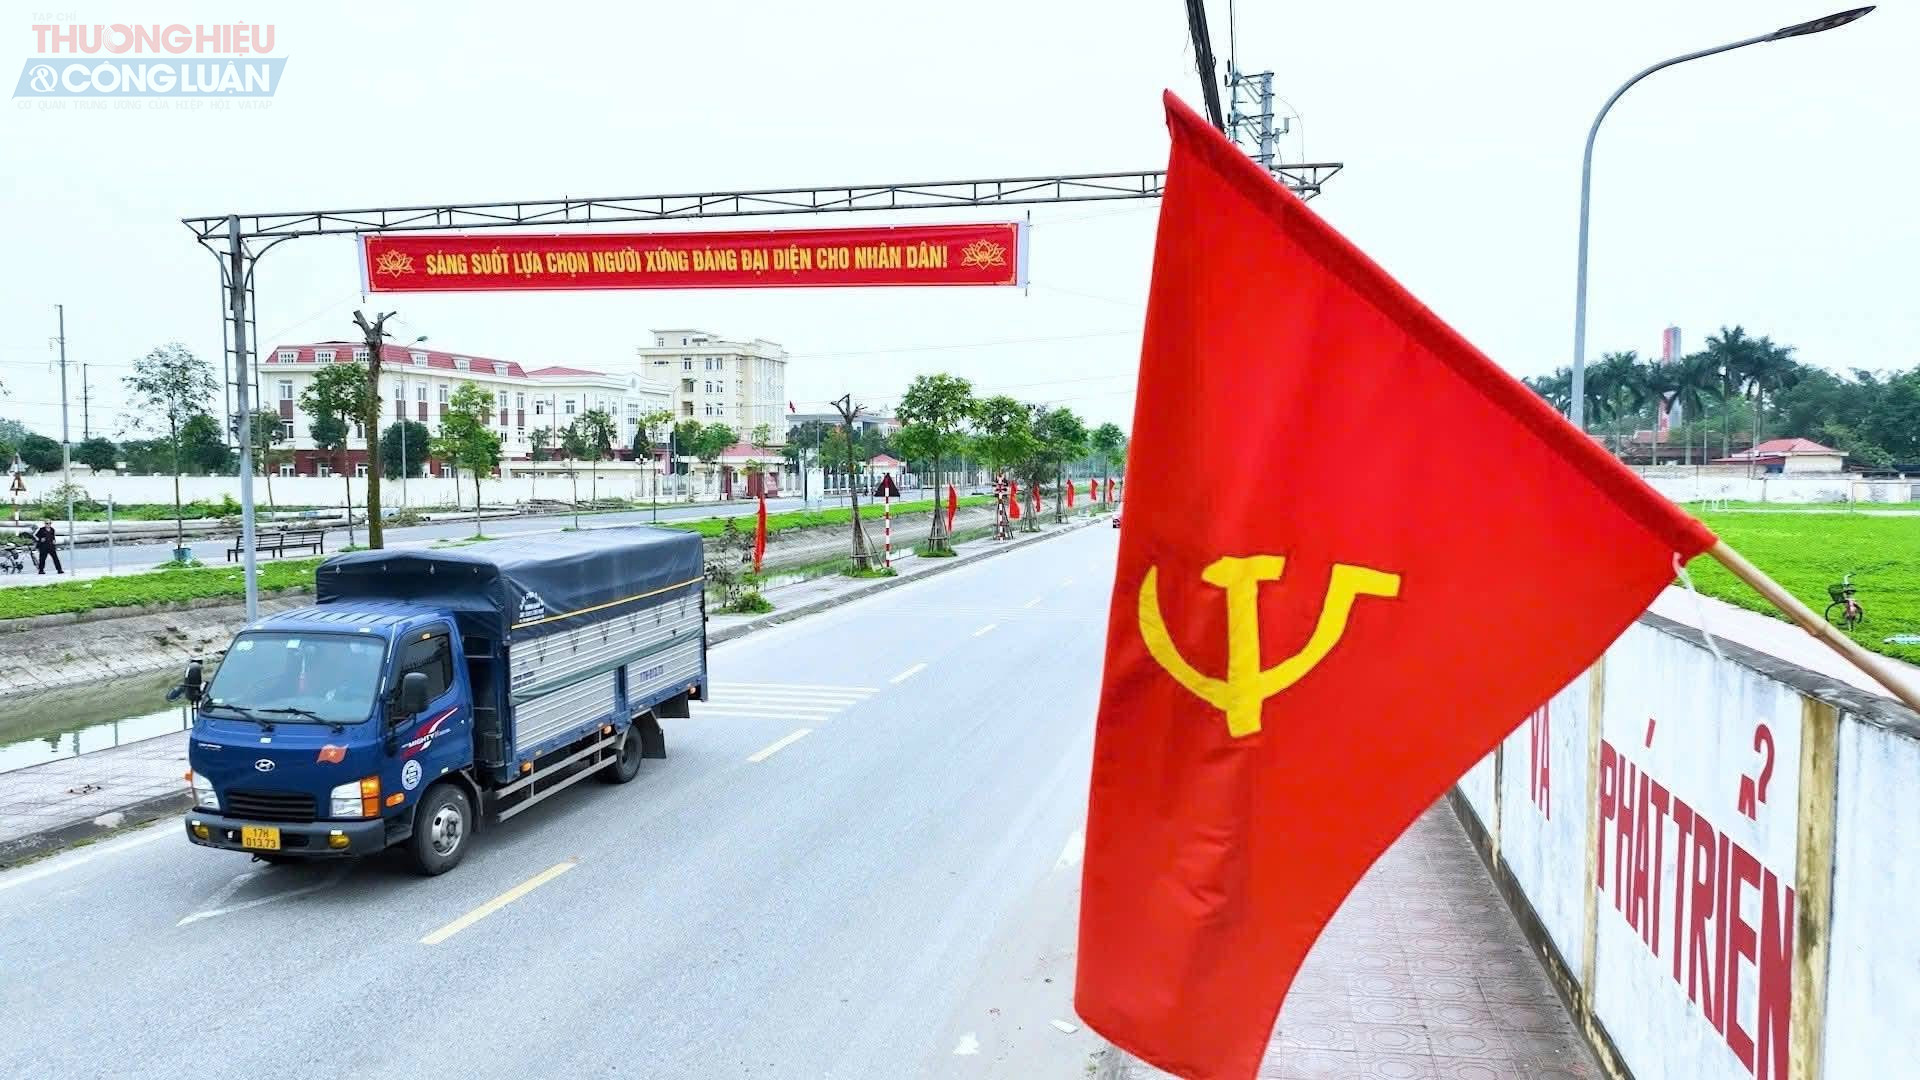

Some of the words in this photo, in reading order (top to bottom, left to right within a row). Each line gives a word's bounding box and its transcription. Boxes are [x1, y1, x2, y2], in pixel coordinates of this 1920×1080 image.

[427, 250, 468, 274] SÁNG
[471, 246, 509, 274] SUỐT
[513, 251, 543, 278] LỰA
[546, 252, 588, 278] CHỌN
[593, 246, 640, 273] NGƯỜI
[647, 247, 689, 271] XỨNG
[693, 245, 736, 271] ĐÁNG
[742, 249, 768, 275] ĐẠI
[774, 245, 811, 275] DIỆN
[816, 248, 849, 269] CHO
[855, 243, 901, 268] NHÂN
[907, 242, 948, 268] DÂN!
[253, 828, 269, 838] 17H
[1598, 718, 1669, 958] PHÁT
[1673, 724, 1795, 1080] TRIỂN
